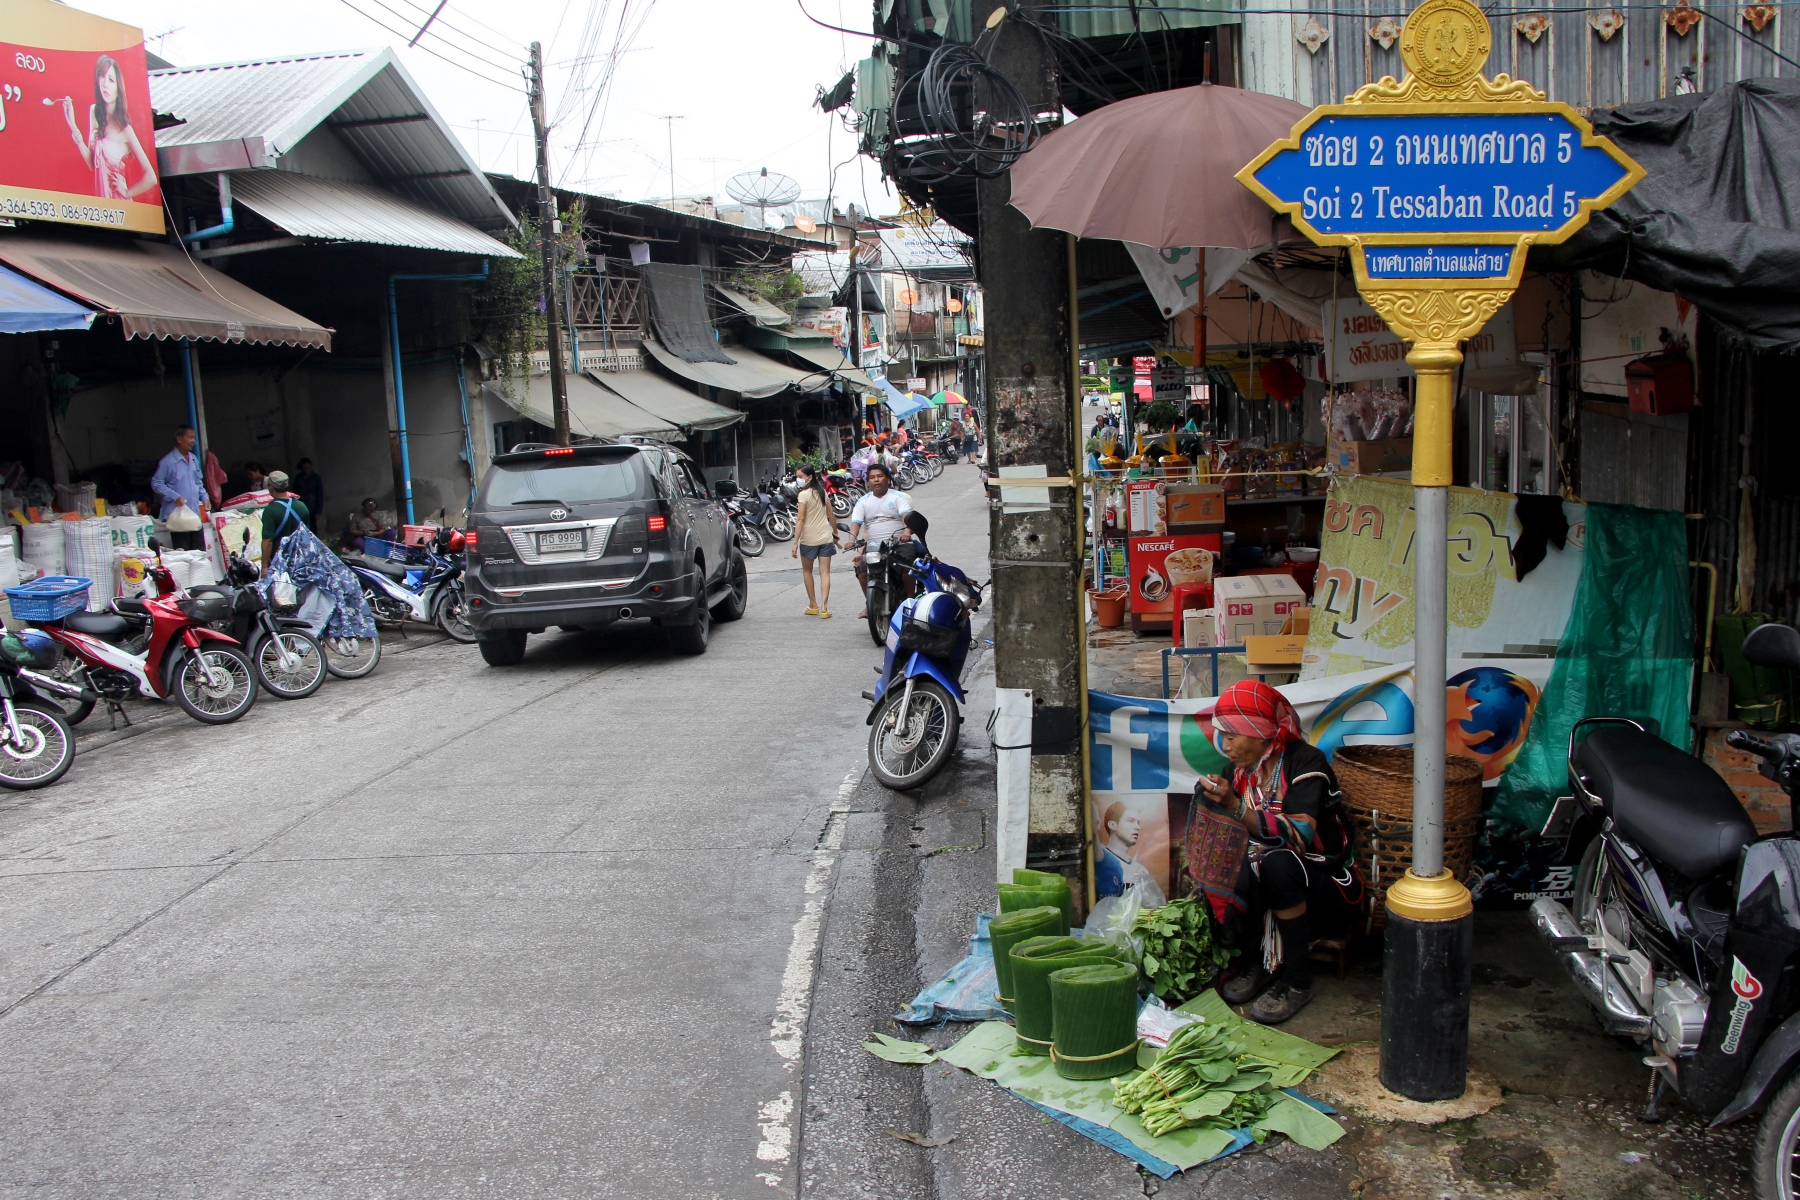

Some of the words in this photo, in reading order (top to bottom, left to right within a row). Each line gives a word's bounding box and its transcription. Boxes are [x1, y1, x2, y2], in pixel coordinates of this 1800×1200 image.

[16, 53, 45, 73] ลอง
[1306, 134, 1357, 166] ซอย
[1369, 136, 1384, 165] 2
[1396, 131, 1546, 165] ถนนเทศบาล
[1557, 133, 1572, 163] 5
[1303, 186, 1341, 219] Soi
[1351, 192, 1363, 219] 2
[1372, 184, 1483, 219] Tessaban
[1492, 184, 1553, 218] Road
[1563, 191, 1576, 218] 5
[61, 204, 125, 225] 086-923-9617
[1372, 248, 1503, 272] เทศบาลตำบลแม่สาย
[558, 532, 581, 543] 9996
[1137, 540, 1174, 551] NESCAFÉ
[1095, 705, 1150, 791] f
[1513, 891, 1548, 900] POINT
[1723, 1001, 1751, 1053] Greenwing
